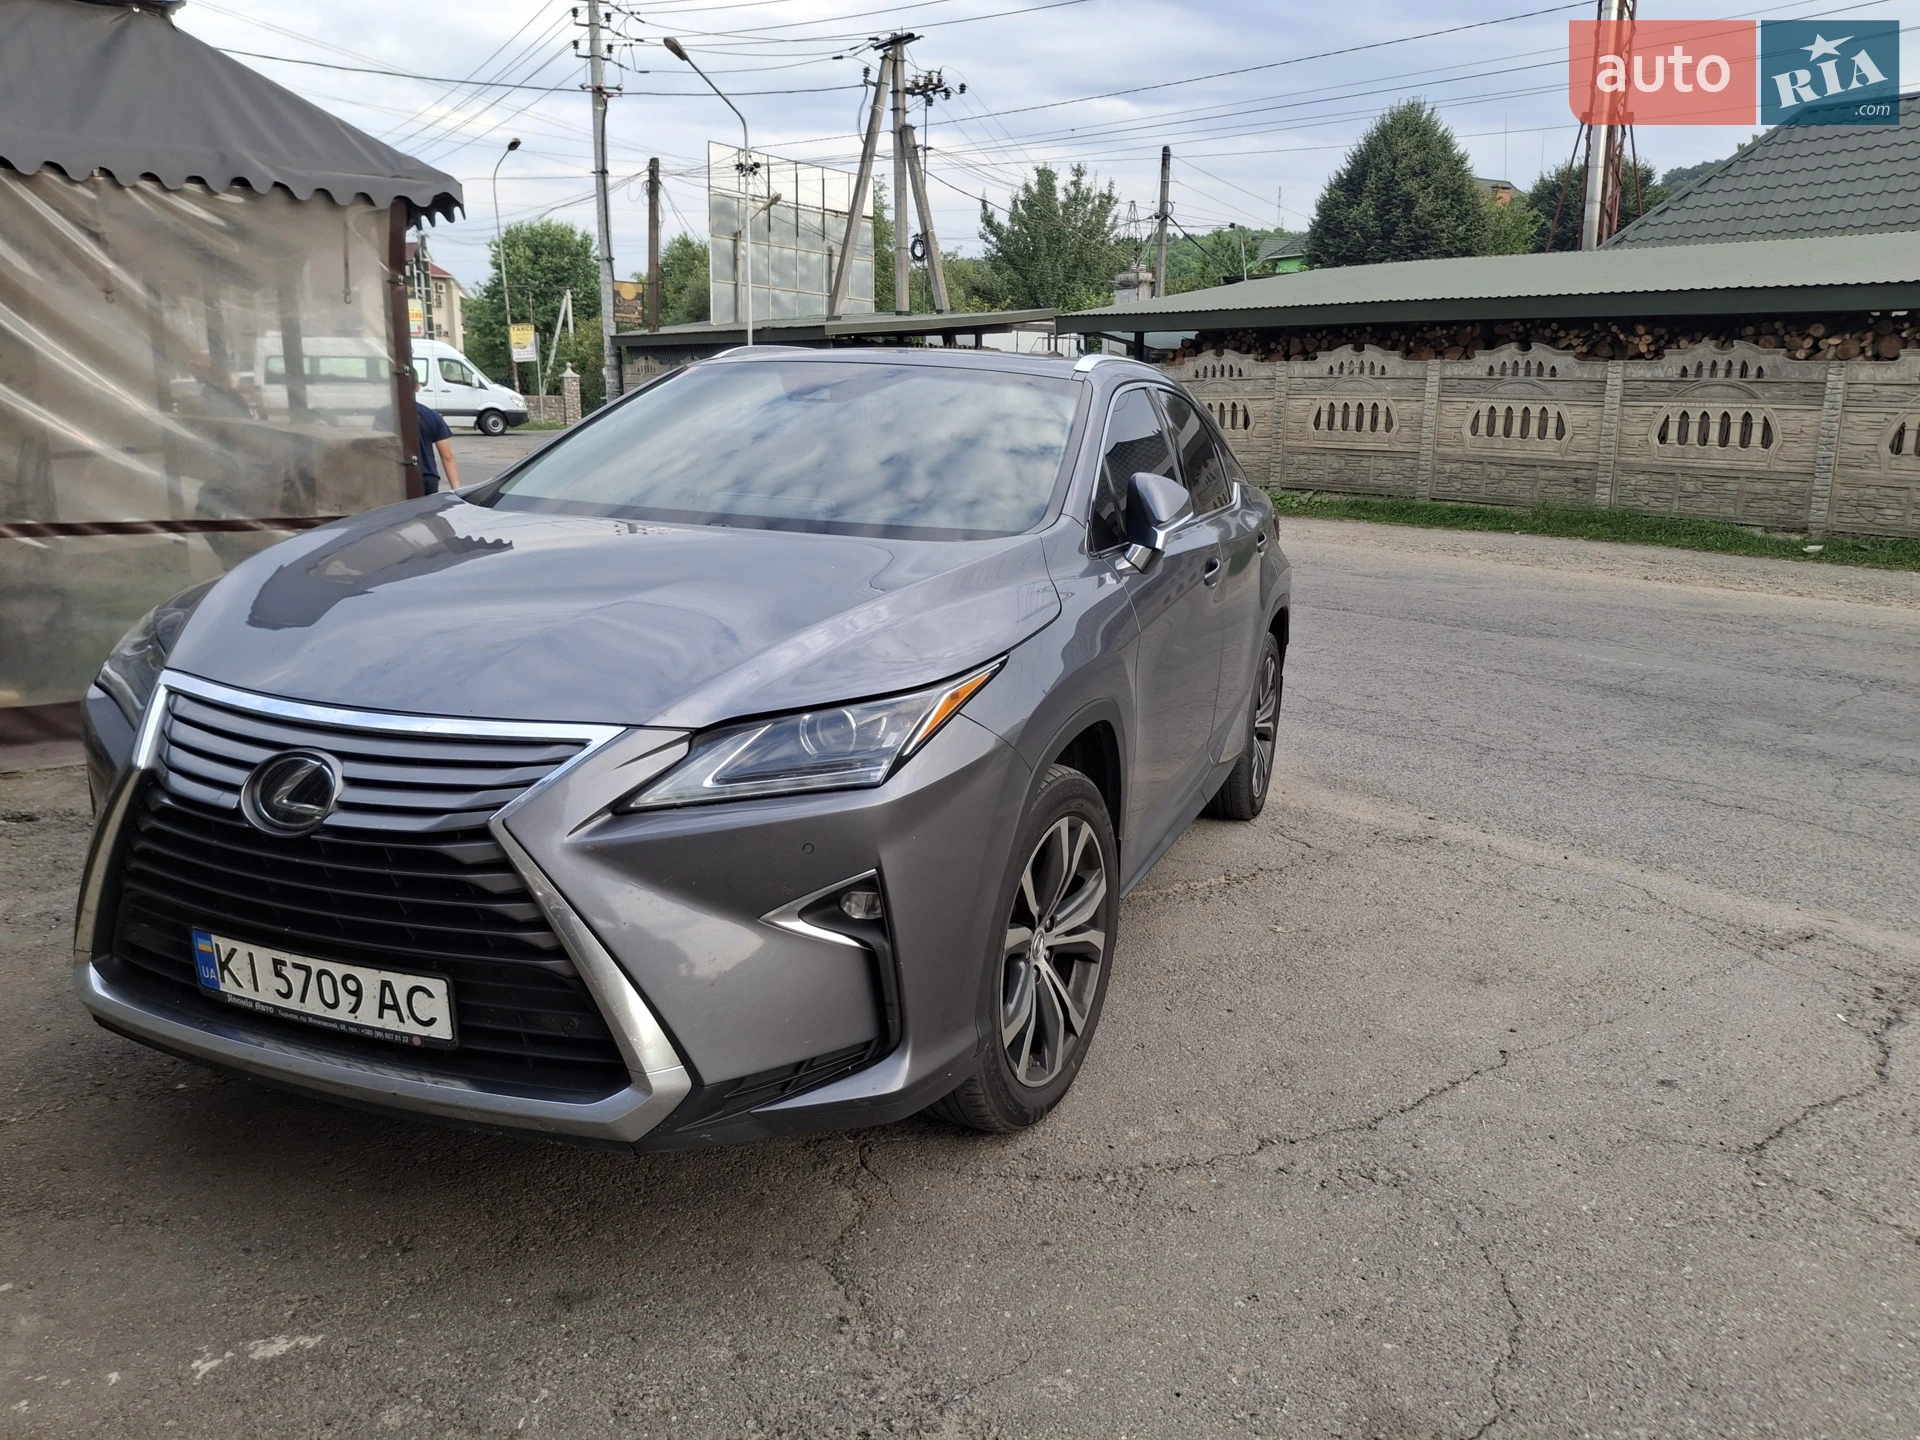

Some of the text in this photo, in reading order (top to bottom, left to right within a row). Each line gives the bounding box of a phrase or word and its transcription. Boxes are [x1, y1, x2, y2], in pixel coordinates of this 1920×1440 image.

[201, 965, 218, 981] UA
[214, 942, 438, 1027] KI 5709 AC
